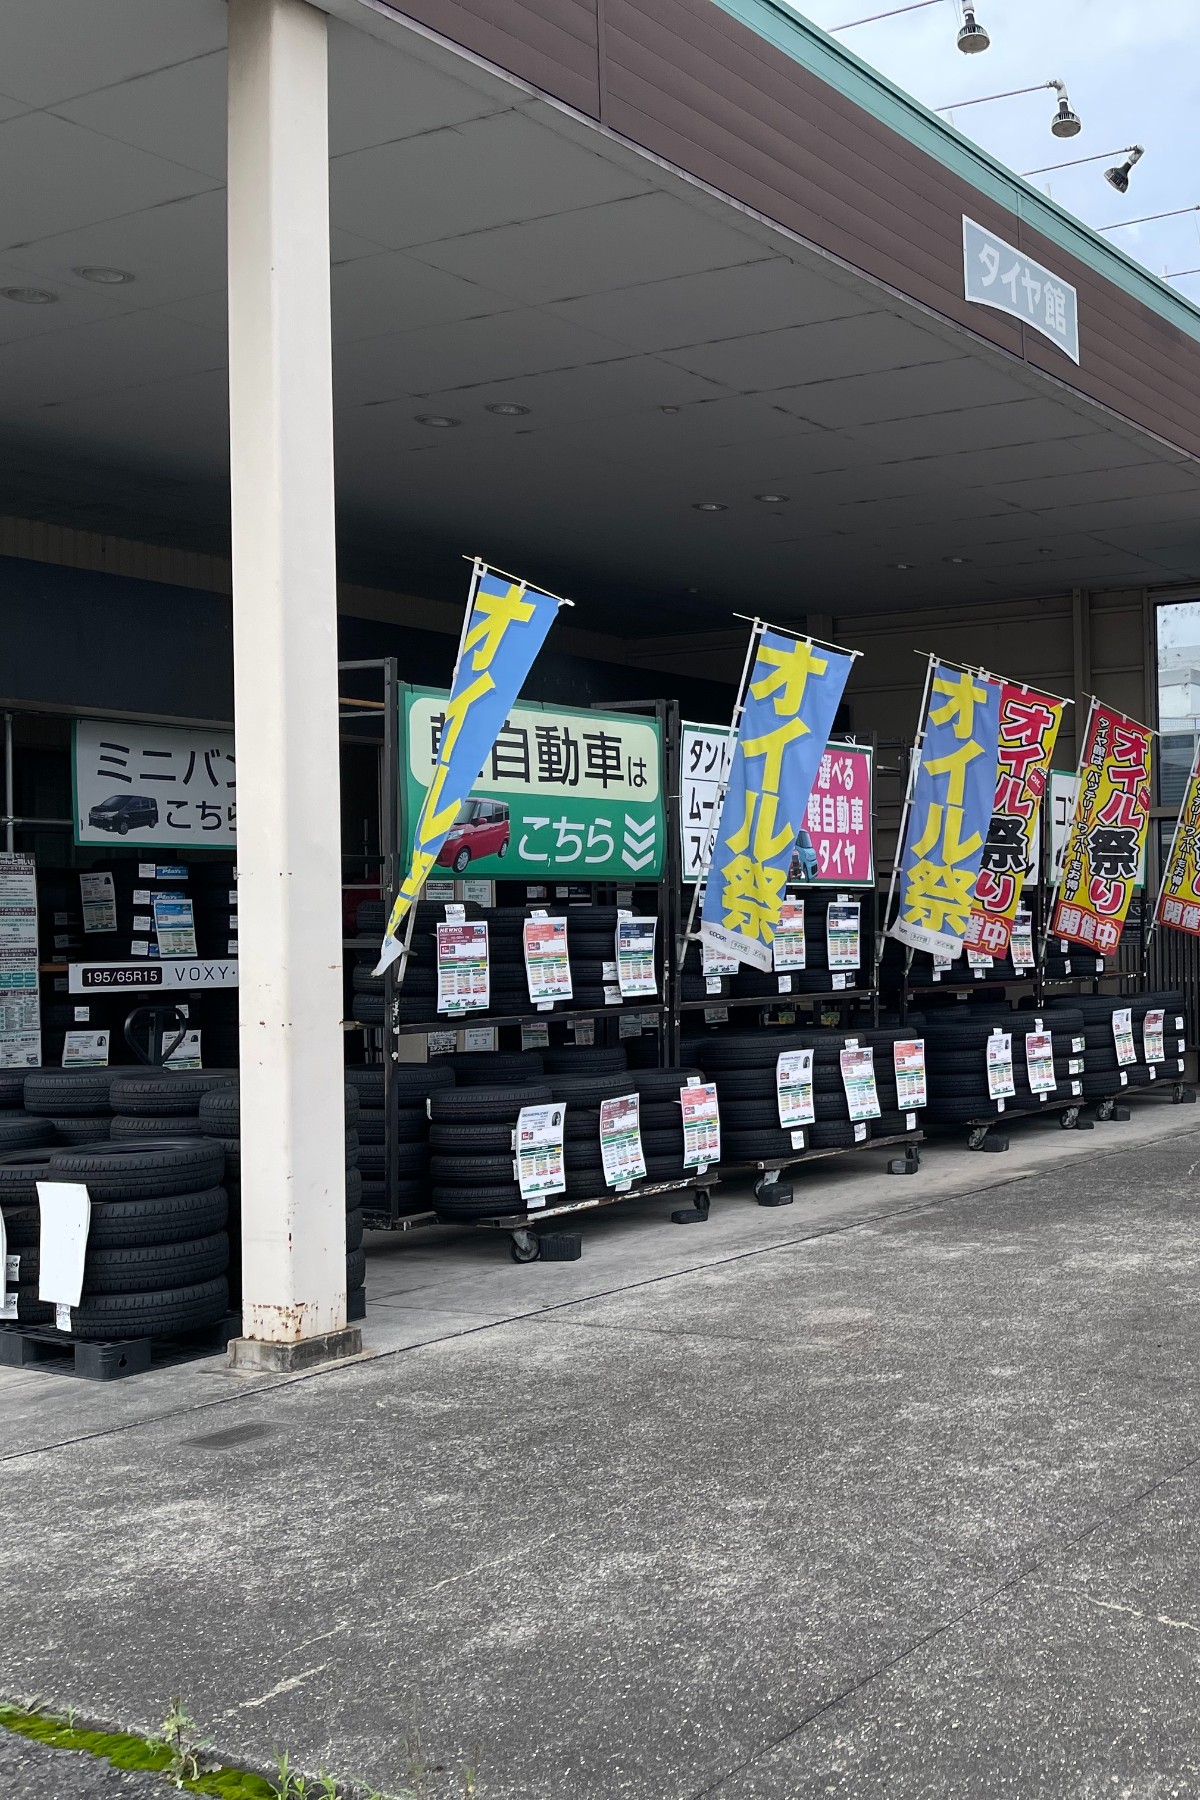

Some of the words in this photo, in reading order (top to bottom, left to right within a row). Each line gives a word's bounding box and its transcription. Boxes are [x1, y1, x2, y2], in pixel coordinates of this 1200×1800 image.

[979, 243, 1067, 336] タイヤ館
[721, 641, 828, 944] オイル祭
[817, 754, 853, 791] 選べる
[807, 796, 864, 835] 軽自動車
[903, 673, 987, 936] オイル祭
[1088, 728, 1148, 914] オイル祭り
[518, 816, 615, 864] こちら
[818, 839, 857, 875] タイヤ
[965, 913, 1007, 949] 催中
[1056, 906, 1118, 948] 開催中
[86, 970, 158, 983] 195/65R15
